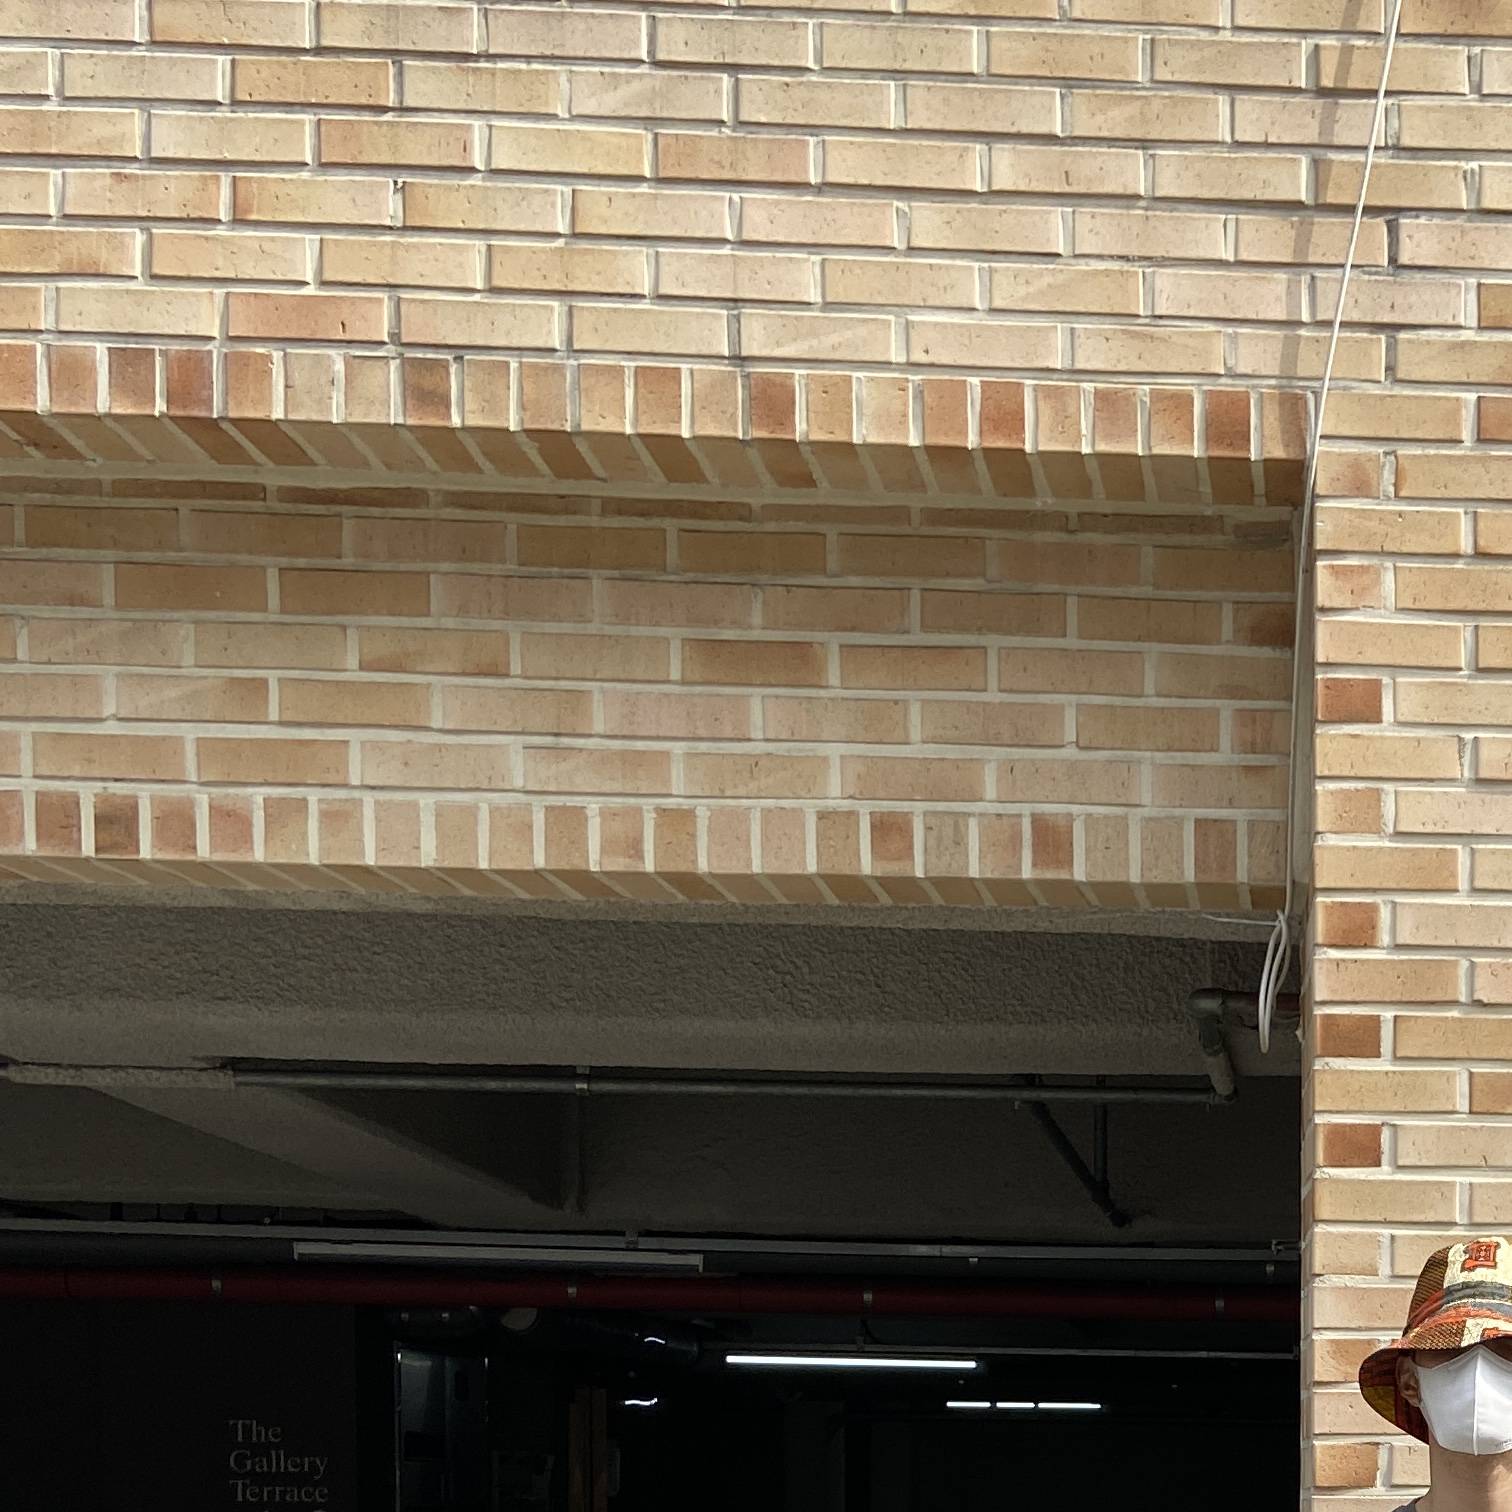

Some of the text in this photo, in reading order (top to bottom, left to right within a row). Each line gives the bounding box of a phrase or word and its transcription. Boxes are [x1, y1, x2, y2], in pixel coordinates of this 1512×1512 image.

[229, 1419, 283, 1443] The
[229, 1450, 329, 1480] Gallery
[229, 1479, 329, 1502] Terrace
